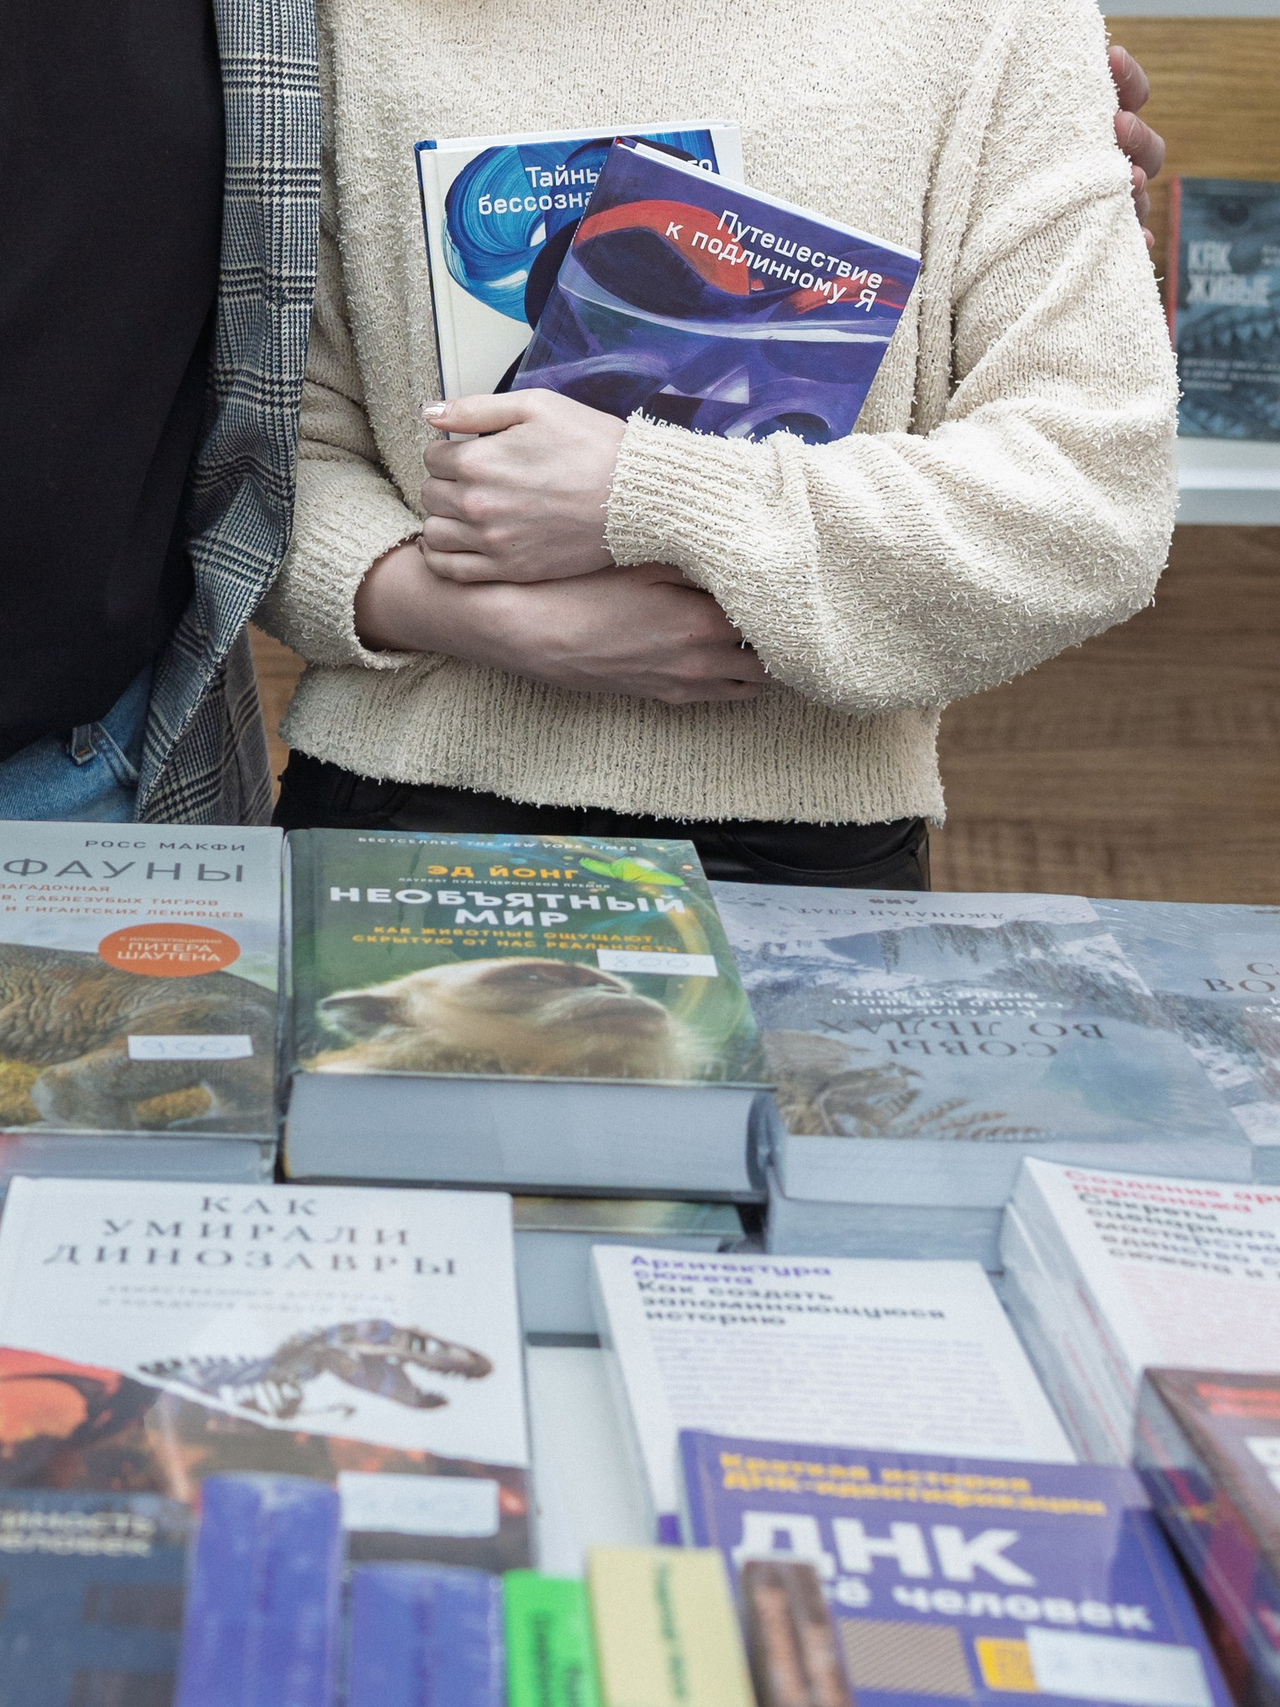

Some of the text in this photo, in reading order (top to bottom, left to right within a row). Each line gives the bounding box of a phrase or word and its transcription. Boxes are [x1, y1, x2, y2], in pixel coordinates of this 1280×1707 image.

[718, 209, 883, 290] Путешествие
[666, 221, 878, 312] к подлинному Я
[85, 840, 246, 852] РОСС МАКФИ
[358, 837, 458, 845] БЕСТСЕЛЛЕР
[427, 864, 579, 880] ЭД ЙОНГ
[563, 882, 611, 890] ПРЕМИИ
[26, 895, 142, 905] САБЛЕЗУБЫХ
[151, 898, 219, 907] ТИГРОВ
[330, 886, 686, 914] НЕОБЪЯТНЫЙ
[5, 905, 244, 919] И ГИГАНТСКИХ ЛЕНИВЦЕВ
[454, 908, 569, 928] МИР
[797, 906, 1006, 920] ДЖОНАТАН СЛАТ
[352, 934, 679, 954] СКРЫТУЮ ОТ НАС РЕАЛЬНОСТЬ
[373, 926, 653, 944] КАК ЖИВОТНЫЕ ОЩУЩАЮТ
[116, 950, 222, 963] ШАУТЕНА
[128, 942, 213, 954] ПИТЕРА
[1200, 978, 1276, 994] ВО
[815, 1017, 1109, 1041] ВО ЛЬДАХ
[885, 1038, 1058, 1058] СОВЫ
[201, 1194, 319, 1218] КАК
[1078, 1192, 1218, 1221] Секреты
[101, 1218, 410, 1247] УМИРАЛИ
[42, 1243, 457, 1277] ДИНОЗАВРЫ
[631, 1255, 832, 1278] Архитектура
[633, 1269, 754, 1286] сюжета
[637, 1281, 835, 1301] Как создать
[642, 1296, 946, 1320] запоминающуюся
[645, 1310, 786, 1326] историю
[731, 1509, 1037, 1588] ДНК
[891, 1584, 1154, 1632] человек
